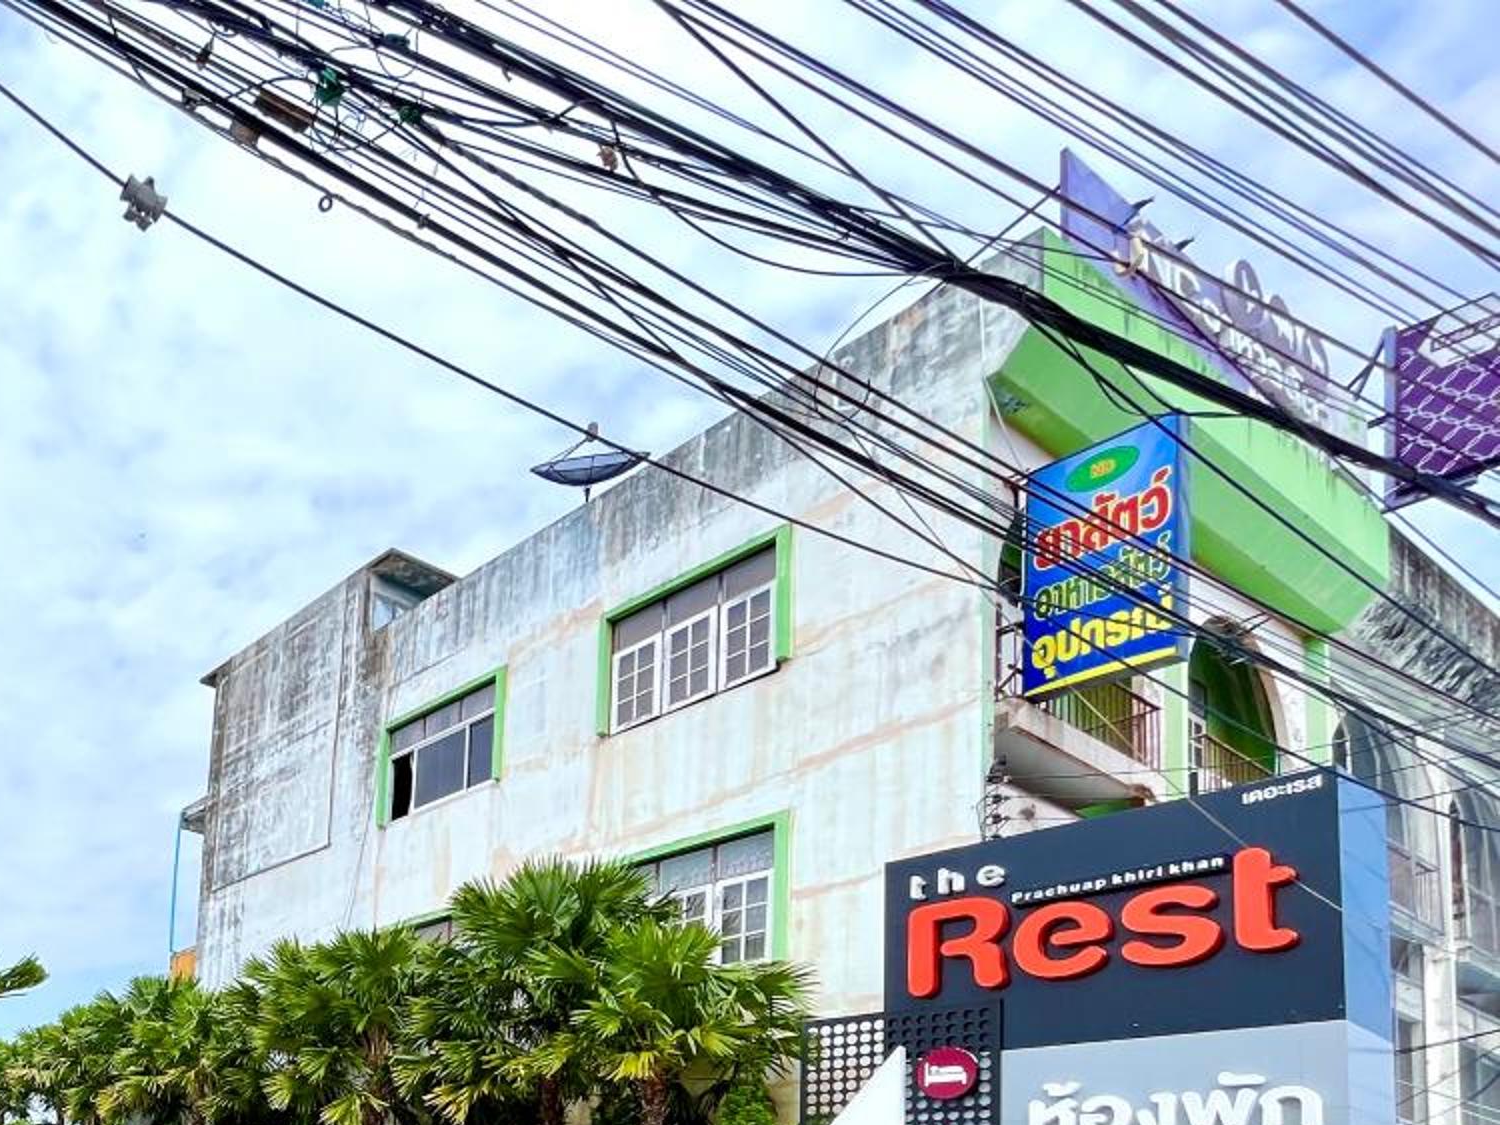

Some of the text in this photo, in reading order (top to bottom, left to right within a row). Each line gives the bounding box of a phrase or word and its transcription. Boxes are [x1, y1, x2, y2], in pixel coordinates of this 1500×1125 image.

[1034, 465, 1172, 570] ยาสัตว์
[1031, 583, 1174, 678] อุปกรณ์
[906, 846, 1300, 998] Rest
[909, 864, 1005, 900] the
[1011, 857, 1225, 904] Prachuap khiri khan
